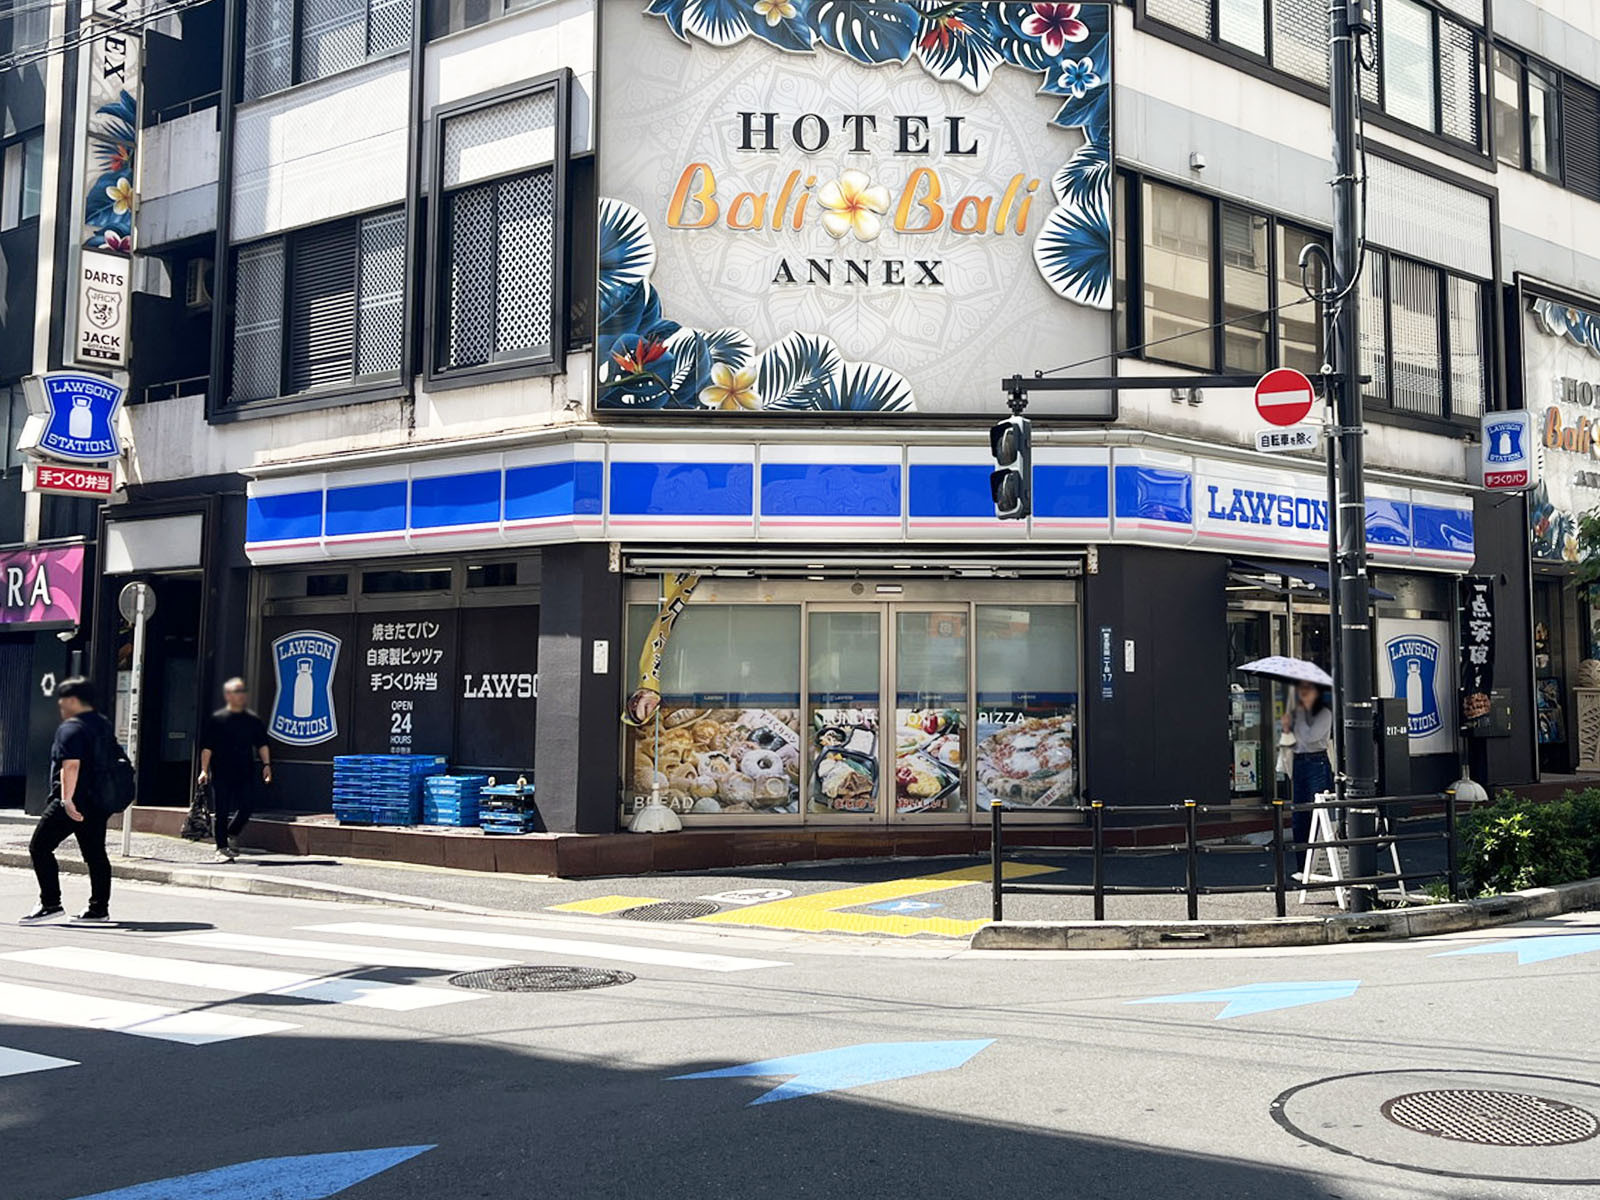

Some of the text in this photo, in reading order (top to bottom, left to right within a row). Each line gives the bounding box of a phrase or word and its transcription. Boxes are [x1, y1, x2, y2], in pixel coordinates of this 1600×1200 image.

[736, 111, 979, 156] HOTEL
[666, 162, 1041, 235] Bali Bali
[84, 268, 124, 287] DARTS
[771, 257, 944, 287] ANNEX
[91, 293, 117, 303] JACK
[82, 331, 121, 347] JACK
[52, 381, 114, 401] LAWSON
[1488, 424, 1521, 434] LAWSON
[1542, 405, 1592, 455] Bali
[47, 433, 112, 452] STATION
[1261, 432, 1312, 448] 自転車を除く
[40, 470, 110, 490] 手づくり弁当
[1207, 485, 1329, 532] LAWSON
[7, 565, 52, 607] RA
[372, 621, 440, 641] 焼きたてパン
[279, 640, 333, 660] LAWSON
[366, 647, 444, 666] 自家製ピッツァ
[1390, 642, 1436, 661] LAWSON
[370, 672, 438, 691] 手づくり弁当
[391, 700, 413, 711] OPEN
[275, 715, 329, 735] STATION
[391, 712, 413, 734] 24
[978, 712, 1026, 725] PIZZA
[390, 735, 412, 744] HOURS
